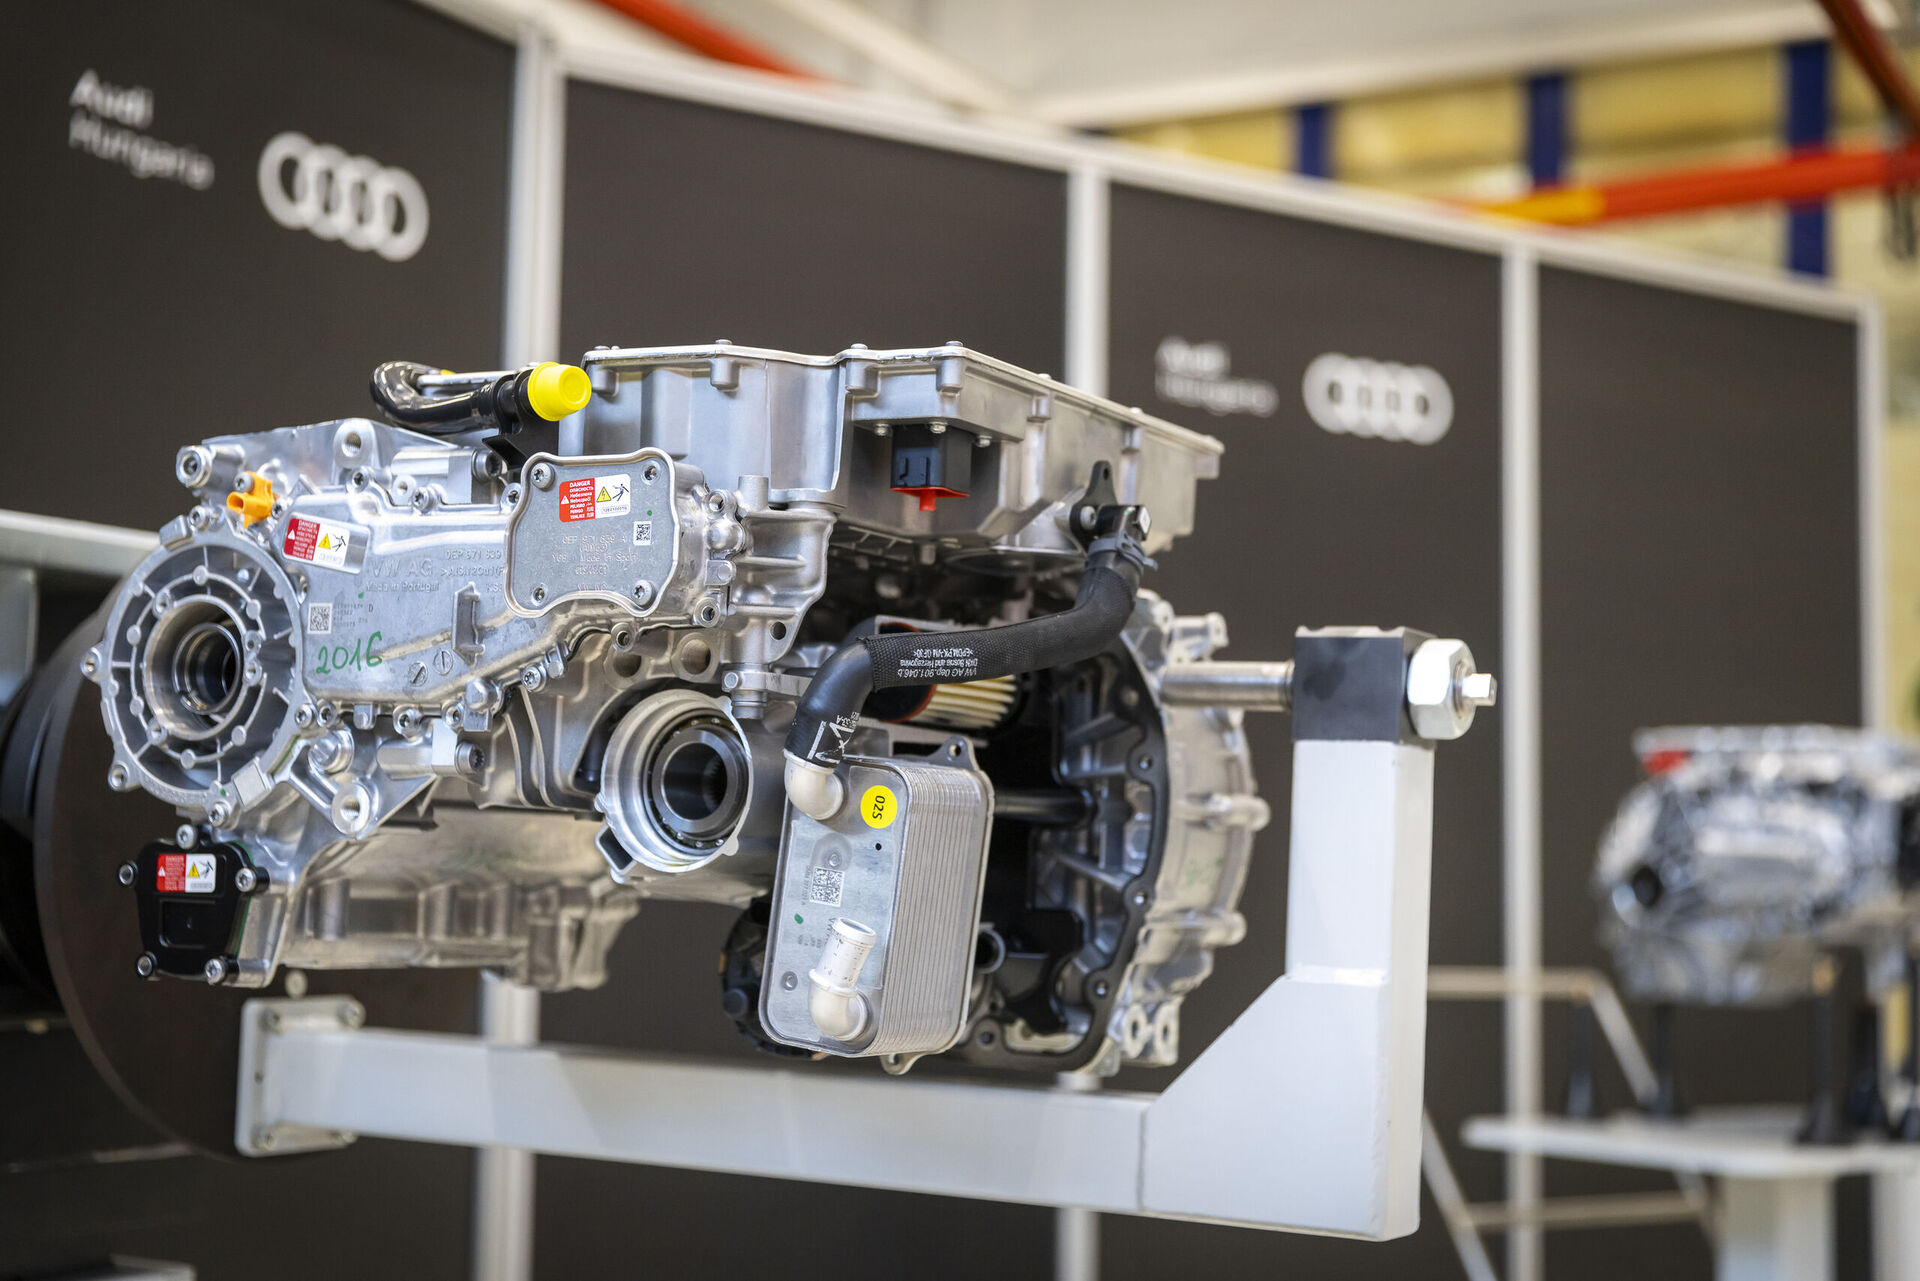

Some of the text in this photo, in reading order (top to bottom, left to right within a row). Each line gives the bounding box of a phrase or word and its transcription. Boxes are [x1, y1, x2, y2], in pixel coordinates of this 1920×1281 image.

[69, 69, 154, 129] Audi
[570, 480, 590, 488] DANGER
[371, 558, 434, 578] VW AG
[401, 581, 440, 593] Portugal
[316, 631, 382, 674] 2016
[935, 659, 946, 668] and
[952, 668, 964, 677] AG
[872, 795, 885, 820] 02S
